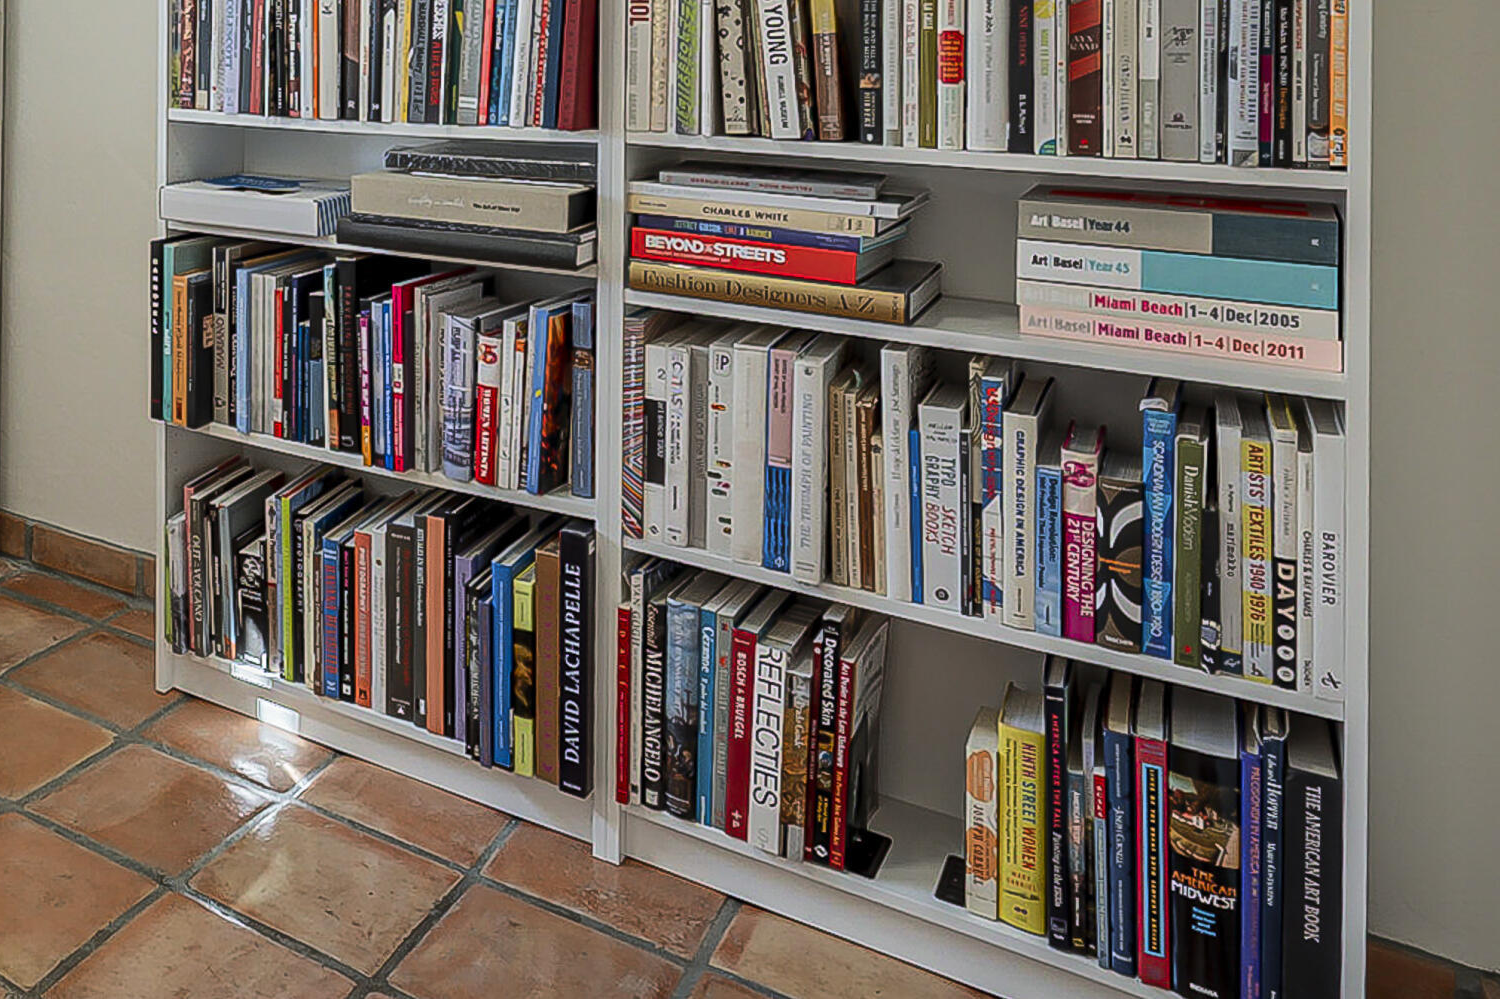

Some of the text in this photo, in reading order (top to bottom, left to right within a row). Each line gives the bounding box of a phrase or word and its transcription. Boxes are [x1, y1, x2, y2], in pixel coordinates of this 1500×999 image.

[417, 2, 427, 45] MARSHALL
[764, 4, 788, 66] YOUNG
[985, 15, 994, 34] Jobs
[1316, 11, 1327, 38] Celebrity
[703, 206, 789, 223] CHARLES WHITE
[1030, 213, 1131, 233] Art Basel Year 44
[644, 234, 786, 264] BEYOND STREETS
[1031, 254, 1131, 274] Art Basel Year 45
[643, 268, 877, 314] Fashion Designers A-Z
[1094, 293, 1136, 312] Miami
[1141, 299, 1183, 317] Beach
[1226, 307, 1253, 325] Dec
[1259, 311, 1300, 329] 2005
[1027, 314, 1050, 330] Art
[1053, 317, 1092, 334] Basel
[1097, 322, 1140, 341] Miami
[1143, 327, 1187, 345] Beach
[1232, 337, 1260, 355] Dec
[1266, 342, 1304, 360] 2011
[480, 389, 492, 478] WOMEN ARTISTS
[800, 392, 813, 549] THE TRIUMPH OF PAINTING
[1183, 464, 1199, 508] Danish
[925, 455, 940, 544] GRAPHY BOOKS
[940, 457, 957, 555] TYPO SKETCH
[1014, 430, 1025, 577] GRAPHIC DESIGN IN AMERICA
[1047, 479, 1058, 563] Design Revolution:
[1150, 440, 1164, 587] SCANDINAVIAN MODERN DESIGN
[192, 535, 200, 561] OUT
[1226, 522, 1237, 577] marimekko
[1248, 444, 1266, 621] ARTISTS' TEXTILES 1940-1976
[1066, 543, 1081, 602] CENTURY
[1081, 520, 1095, 617] DESIGNING THE
[1322, 531, 1336, 605] BAROVIER
[631, 583, 642, 647] VAN GOGH
[1277, 562, 1295, 622] DAY
[564, 562, 580, 764] DAVID LACHAPELLE
[700, 626, 714, 674] Cézanne
[644, 603, 665, 782] Essential MICHELANGELO
[734, 651, 747, 739] BOSCH BRUEGEL
[821, 638, 838, 726] Decorated Skin
[753, 649, 784, 808] REFLECTIES
[1051, 713, 1060, 755] AMERICA
[1021, 743, 1036, 779] NINTH
[1051, 757, 1060, 786] AFTER
[1021, 781, 1036, 825] STREET
[1051, 789, 1060, 806] THE
[1267, 754, 1282, 830] Edward HOPPER
[1052, 808, 1061, 828] FALL
[973, 804, 984, 886] JOSEPH CORNELL
[1021, 826, 1036, 871] WOMEN
[1051, 831, 1062, 864] Painting
[1250, 835, 1259, 875] AMERICA
[1304, 786, 1321, 943] THE AMERICAN ART BOOK
[1052, 874, 1061, 885] the
[1171, 870, 1237, 897] AMERICAN
[1171, 880, 1237, 910] MIDWEST
[1192, 867, 1214, 882] THE
